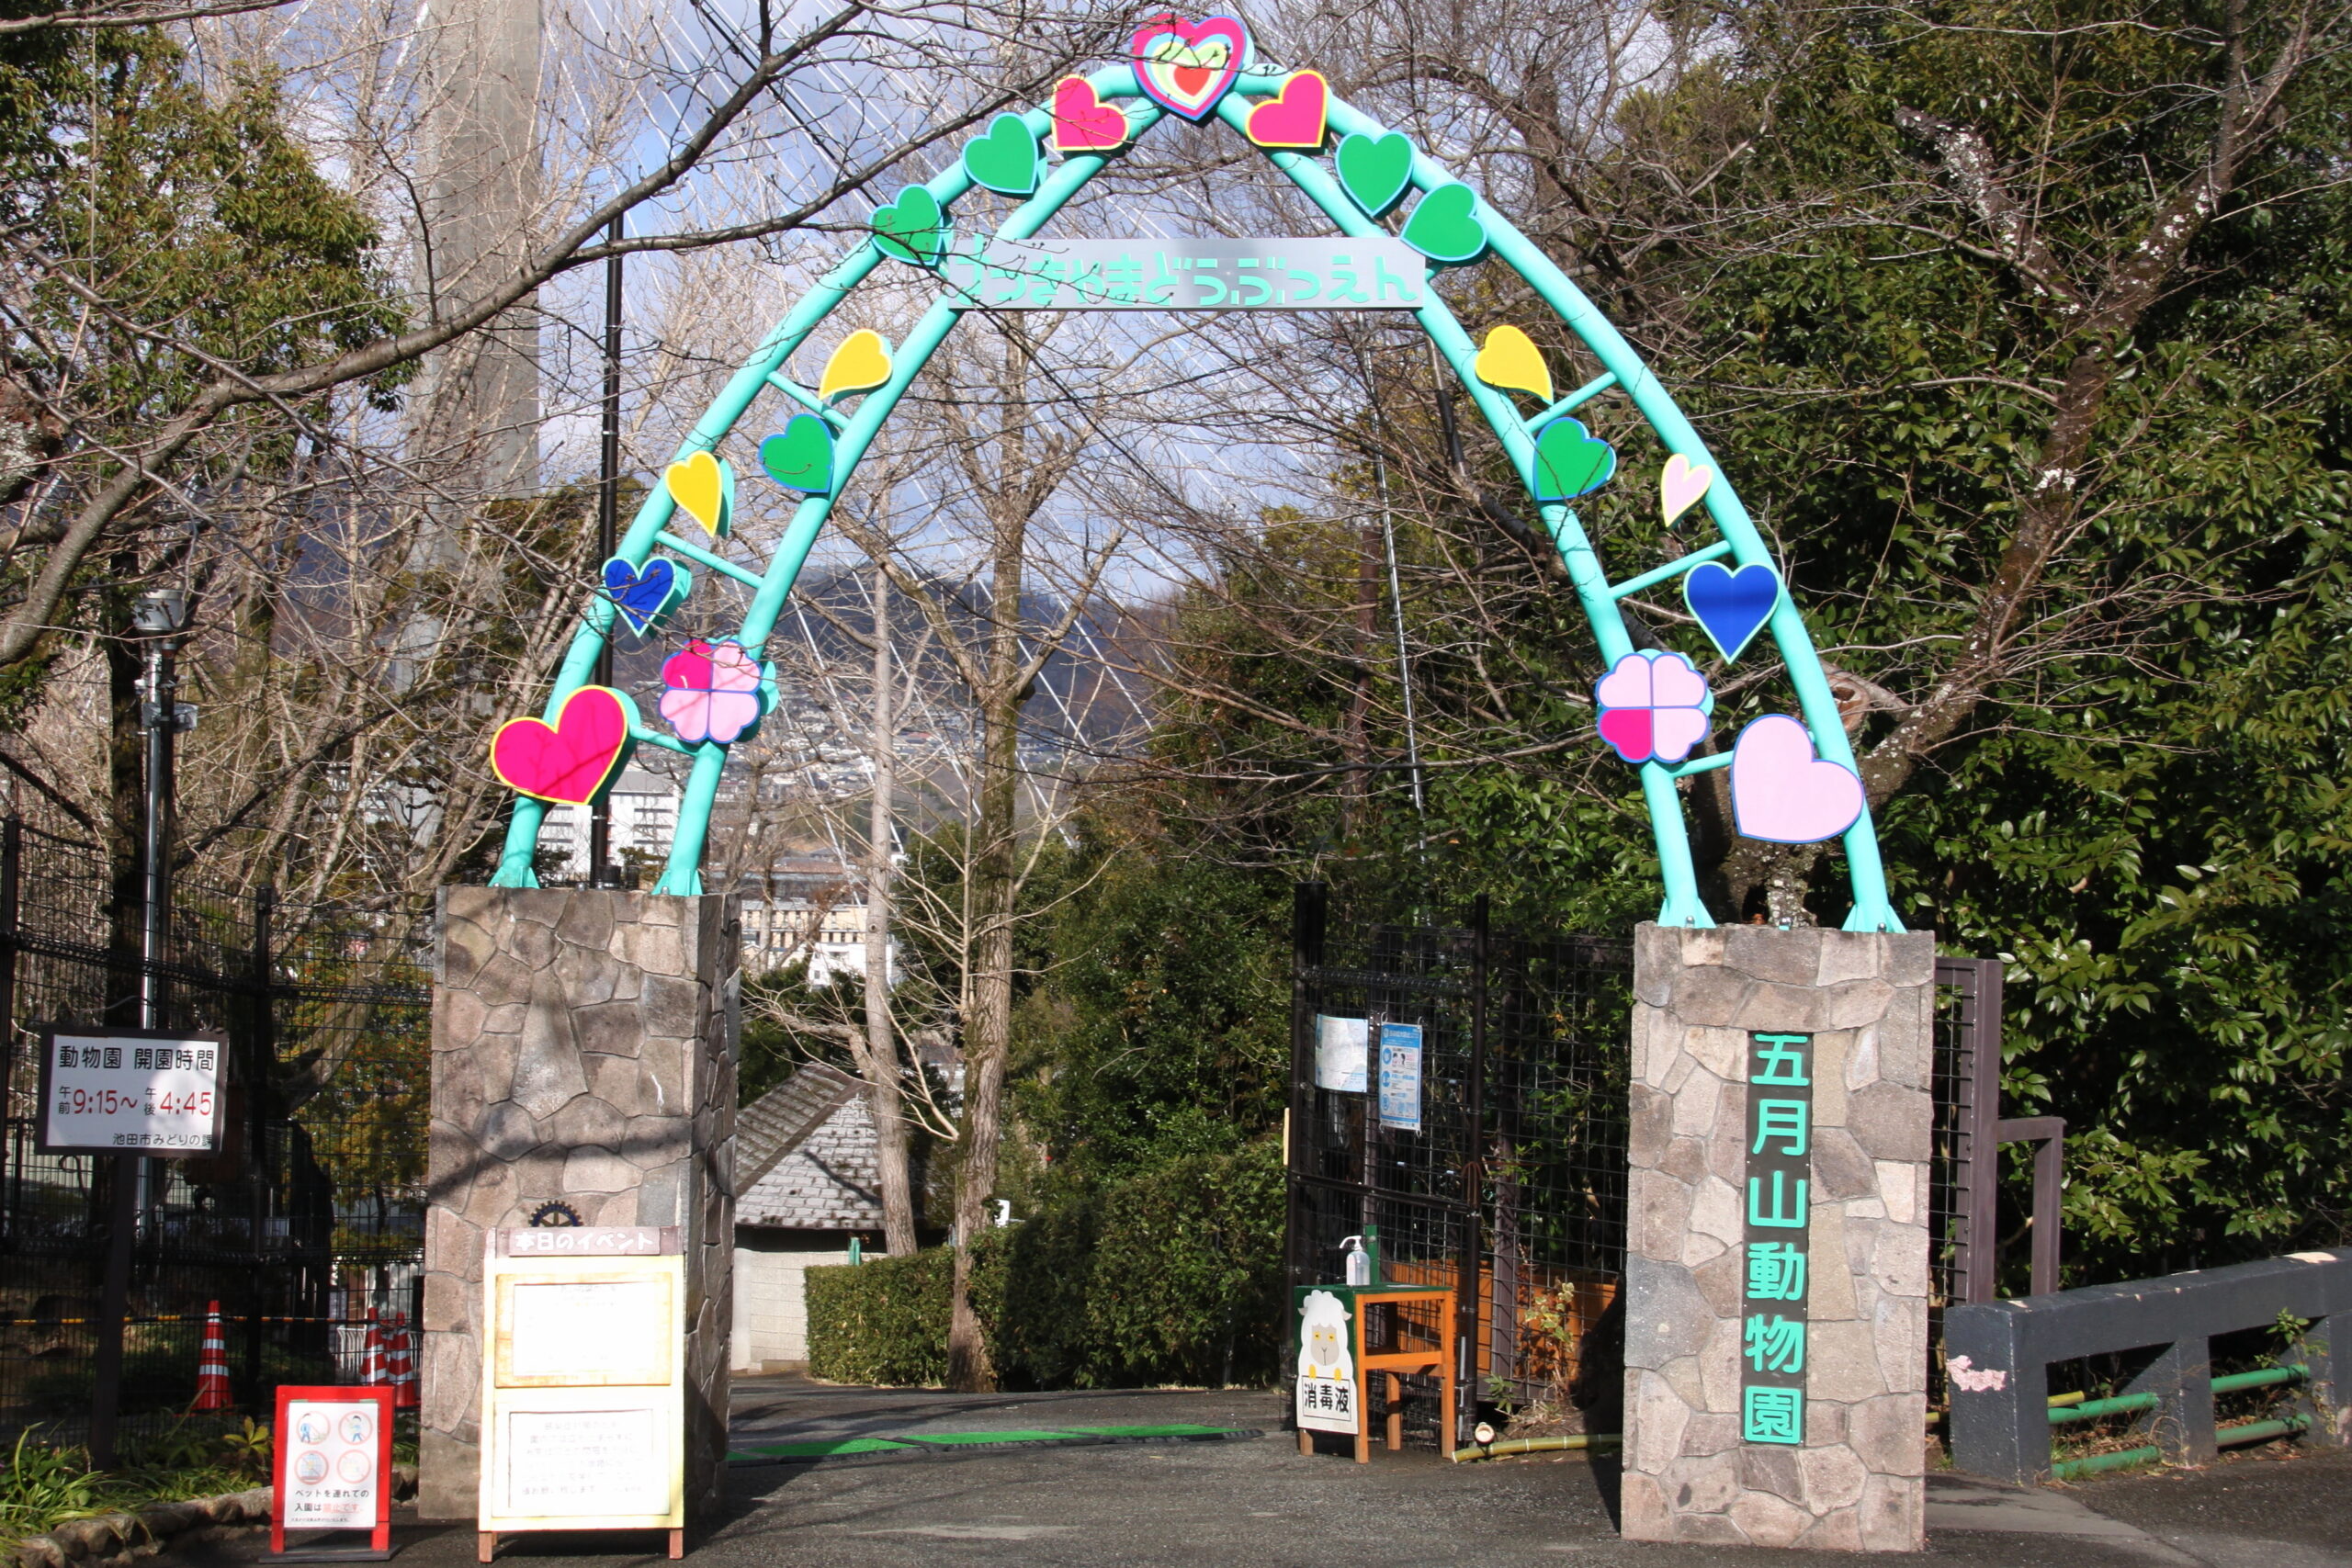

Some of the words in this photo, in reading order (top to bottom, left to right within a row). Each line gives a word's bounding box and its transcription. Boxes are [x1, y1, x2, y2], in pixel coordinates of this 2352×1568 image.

[956, 233, 1417, 306] さつきやまどうぶつえん
[59, 1045, 122, 1069] 動物園
[134, 1048, 213, 1070] 開園時間
[59, 1086, 72, 1114] 午前
[144, 1088, 156, 1116] 午後
[160, 1091, 211, 1115] 4:45
[514, 1231, 655, 1251] 本日のイベント
[1745, 1033, 1809, 1445] 五月山動物園
[1303, 1382, 1349, 1414] 消毒液
